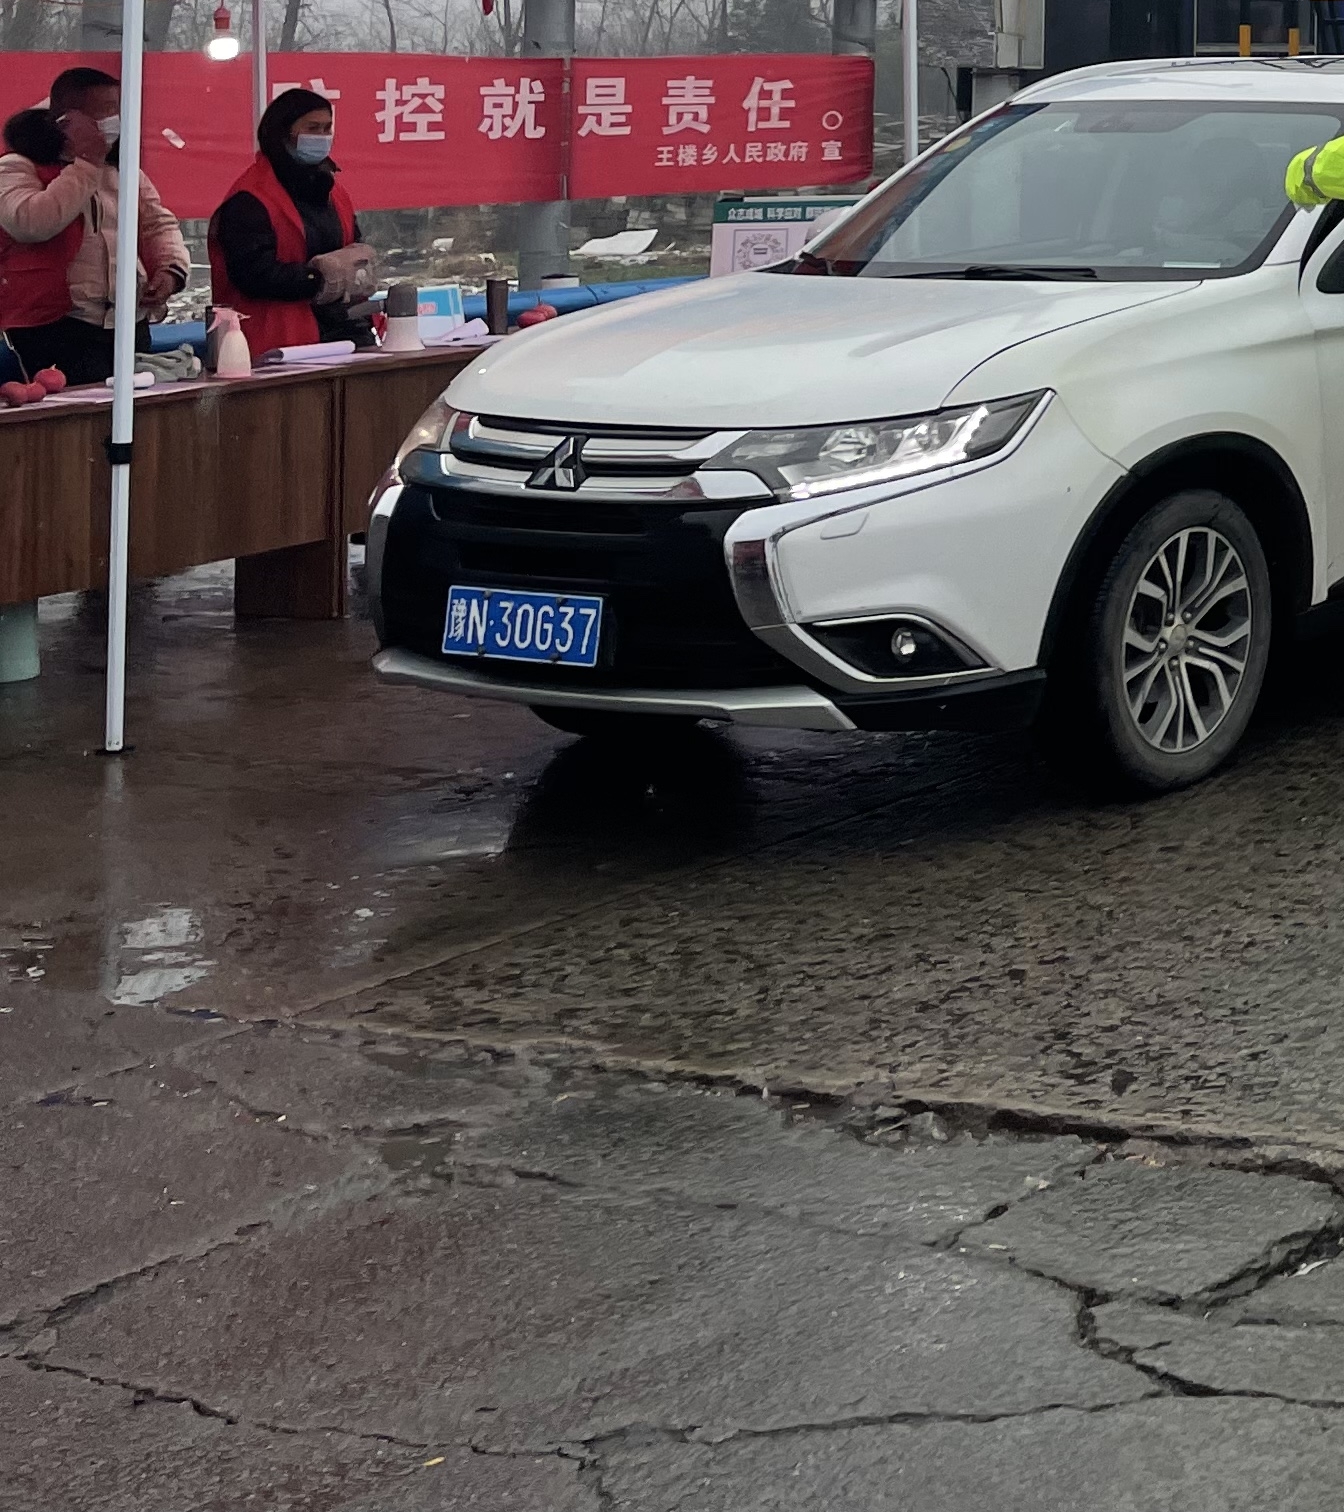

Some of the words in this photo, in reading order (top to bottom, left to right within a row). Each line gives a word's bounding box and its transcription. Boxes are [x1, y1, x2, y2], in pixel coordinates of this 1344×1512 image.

[654, 141, 808, 167] 王楼乡人民政府
[821, 141, 844, 161] 宣
